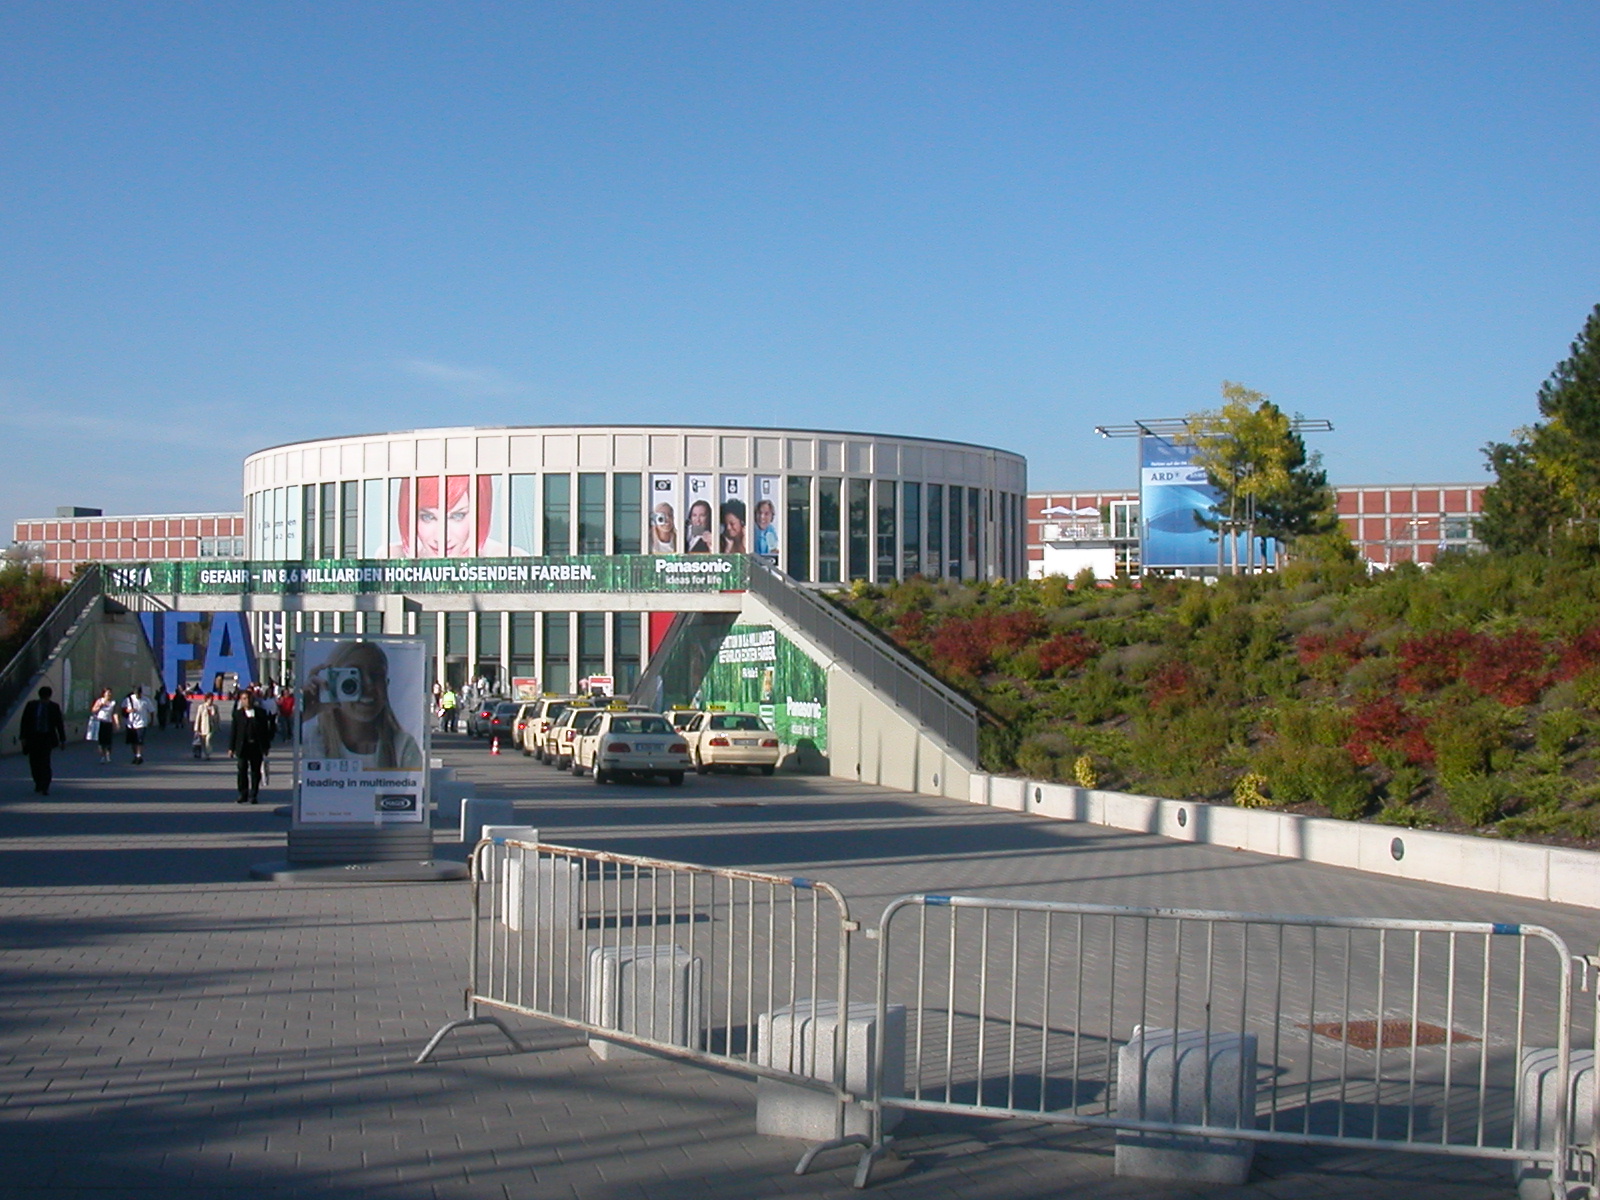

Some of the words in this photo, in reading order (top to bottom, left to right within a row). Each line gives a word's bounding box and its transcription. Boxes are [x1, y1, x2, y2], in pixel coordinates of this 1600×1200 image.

[1150, 472, 1174, 481] ARD
[655, 558, 732, 573] Panasonic
[200, 569, 249, 584] GEFAHR
[262, 568, 276, 583] IN
[279, 569, 298, 585] 8,6
[300, 566, 383, 583] MILLIARDEN
[385, 563, 529, 582] HOCHAUFLÖSENDEN
[531, 564, 596, 581] FARBEN.
[666, 575, 690, 585] ideas
[692, 575, 706, 585] for
[707, 575, 723, 585] life
[140, 612, 256, 695] FA
[306, 778, 345, 788] leading
[347, 778, 357, 787] in
[359, 778, 417, 787] multimedia
